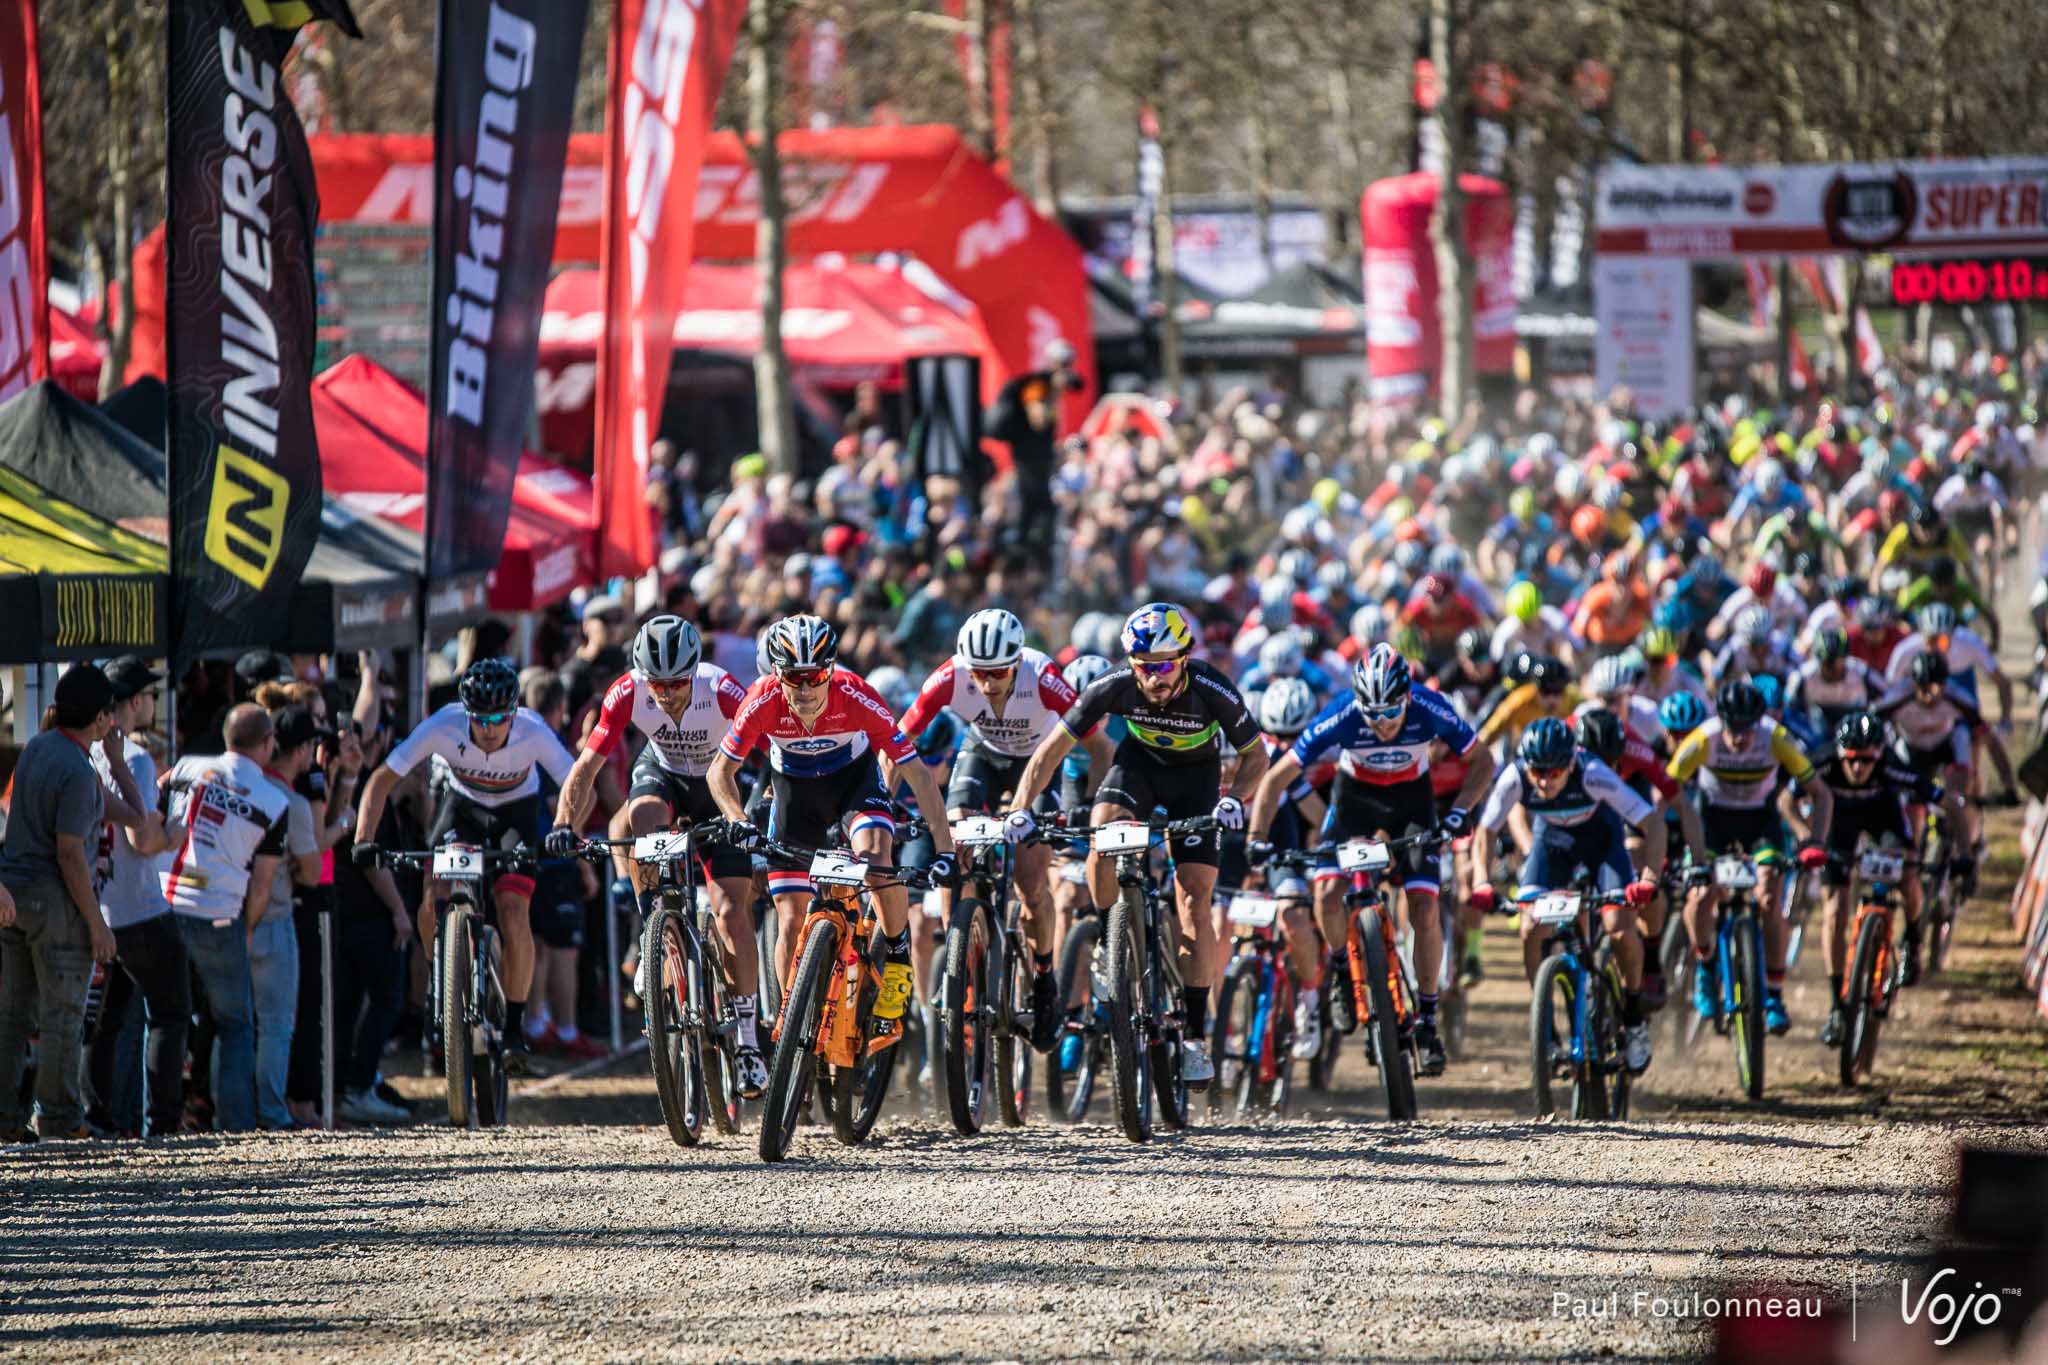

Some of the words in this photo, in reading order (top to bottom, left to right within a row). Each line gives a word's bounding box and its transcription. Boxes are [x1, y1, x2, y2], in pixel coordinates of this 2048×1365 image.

[447, 2, 536, 427] Biking
[220, 27, 278, 457] INVERSE
[603, 678, 633, 711] BMC
[720, 678, 747, 701] BM
[1040, 672, 1077, 702] BMC
[1195, 674, 1240, 704] cannondale
[735, 686, 781, 730] ORBEA
[840, 684, 896, 728] ORBEA
[1123, 713, 1204, 729] cannondale
[975, 823, 985, 835] 4
[1118, 832, 1125, 844] 1
[655, 839, 666, 851] 8
[1357, 848, 1368, 860] 5
[450, 856, 470, 869] 19
[831, 864, 845, 872] 6
